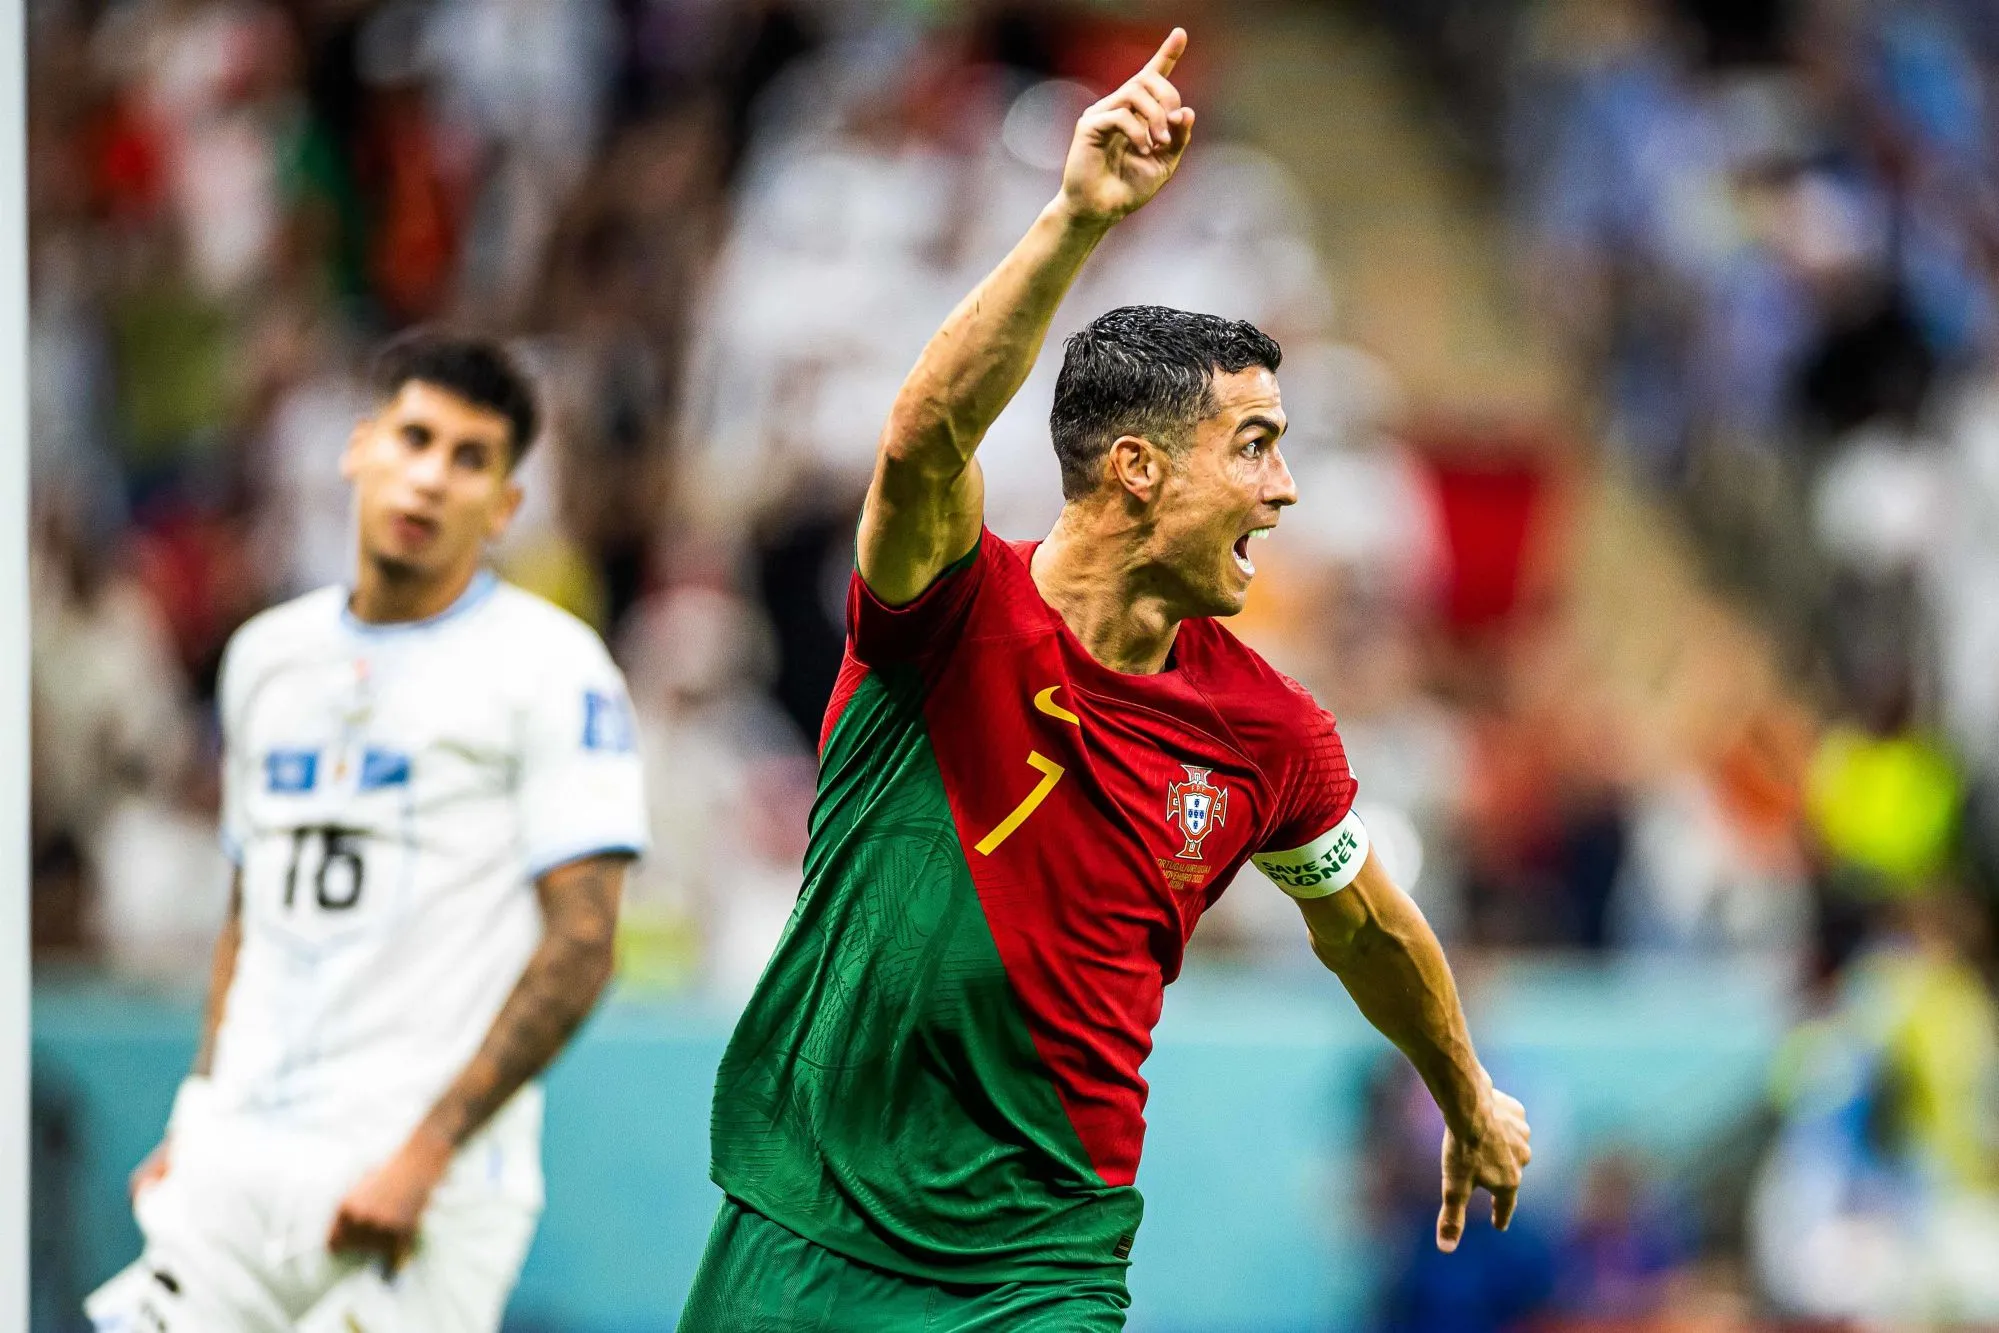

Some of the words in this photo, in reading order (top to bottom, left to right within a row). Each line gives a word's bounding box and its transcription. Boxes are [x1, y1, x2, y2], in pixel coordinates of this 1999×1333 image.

[974, 750, 1066, 857] 7
[1262, 860, 1319, 875] SAVE
[1320, 828, 1350, 862] THE
